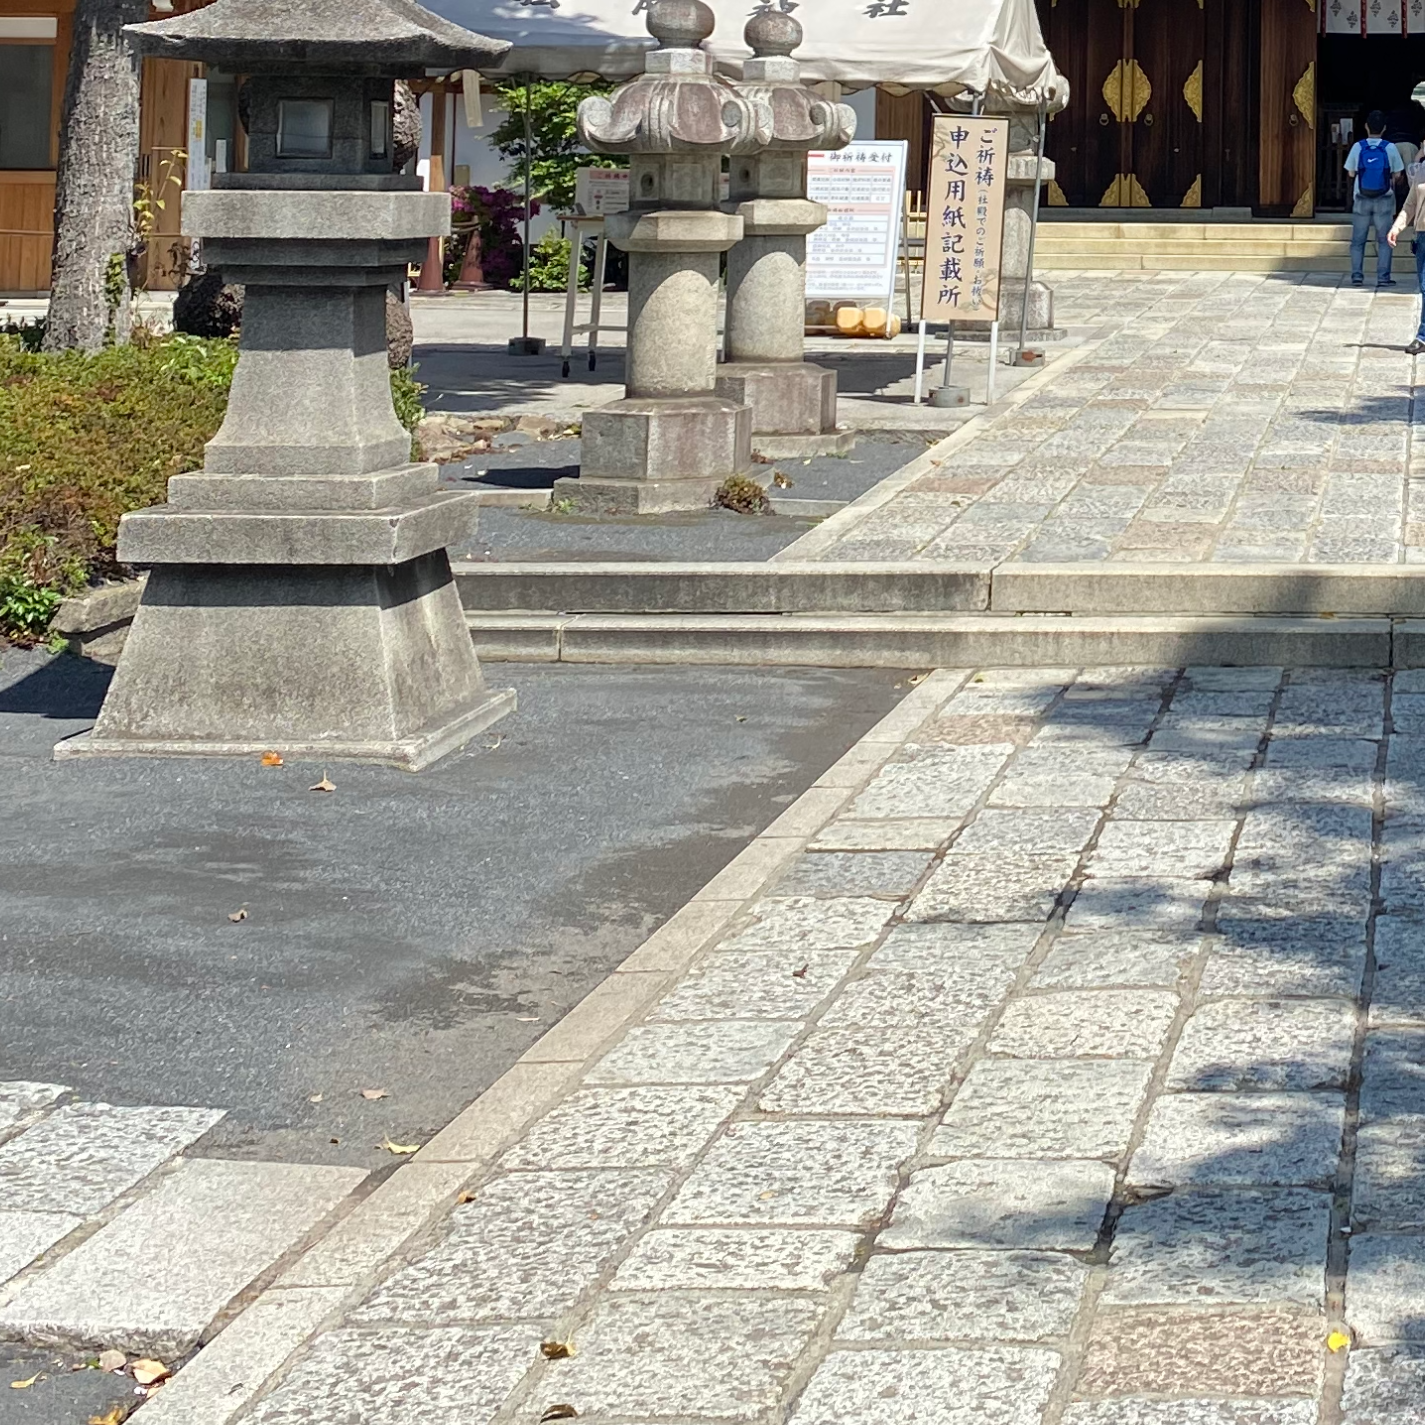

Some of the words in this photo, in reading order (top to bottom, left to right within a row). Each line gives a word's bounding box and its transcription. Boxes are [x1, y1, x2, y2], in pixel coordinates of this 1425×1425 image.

[936, 125, 970, 309] 申込用紙記載所
